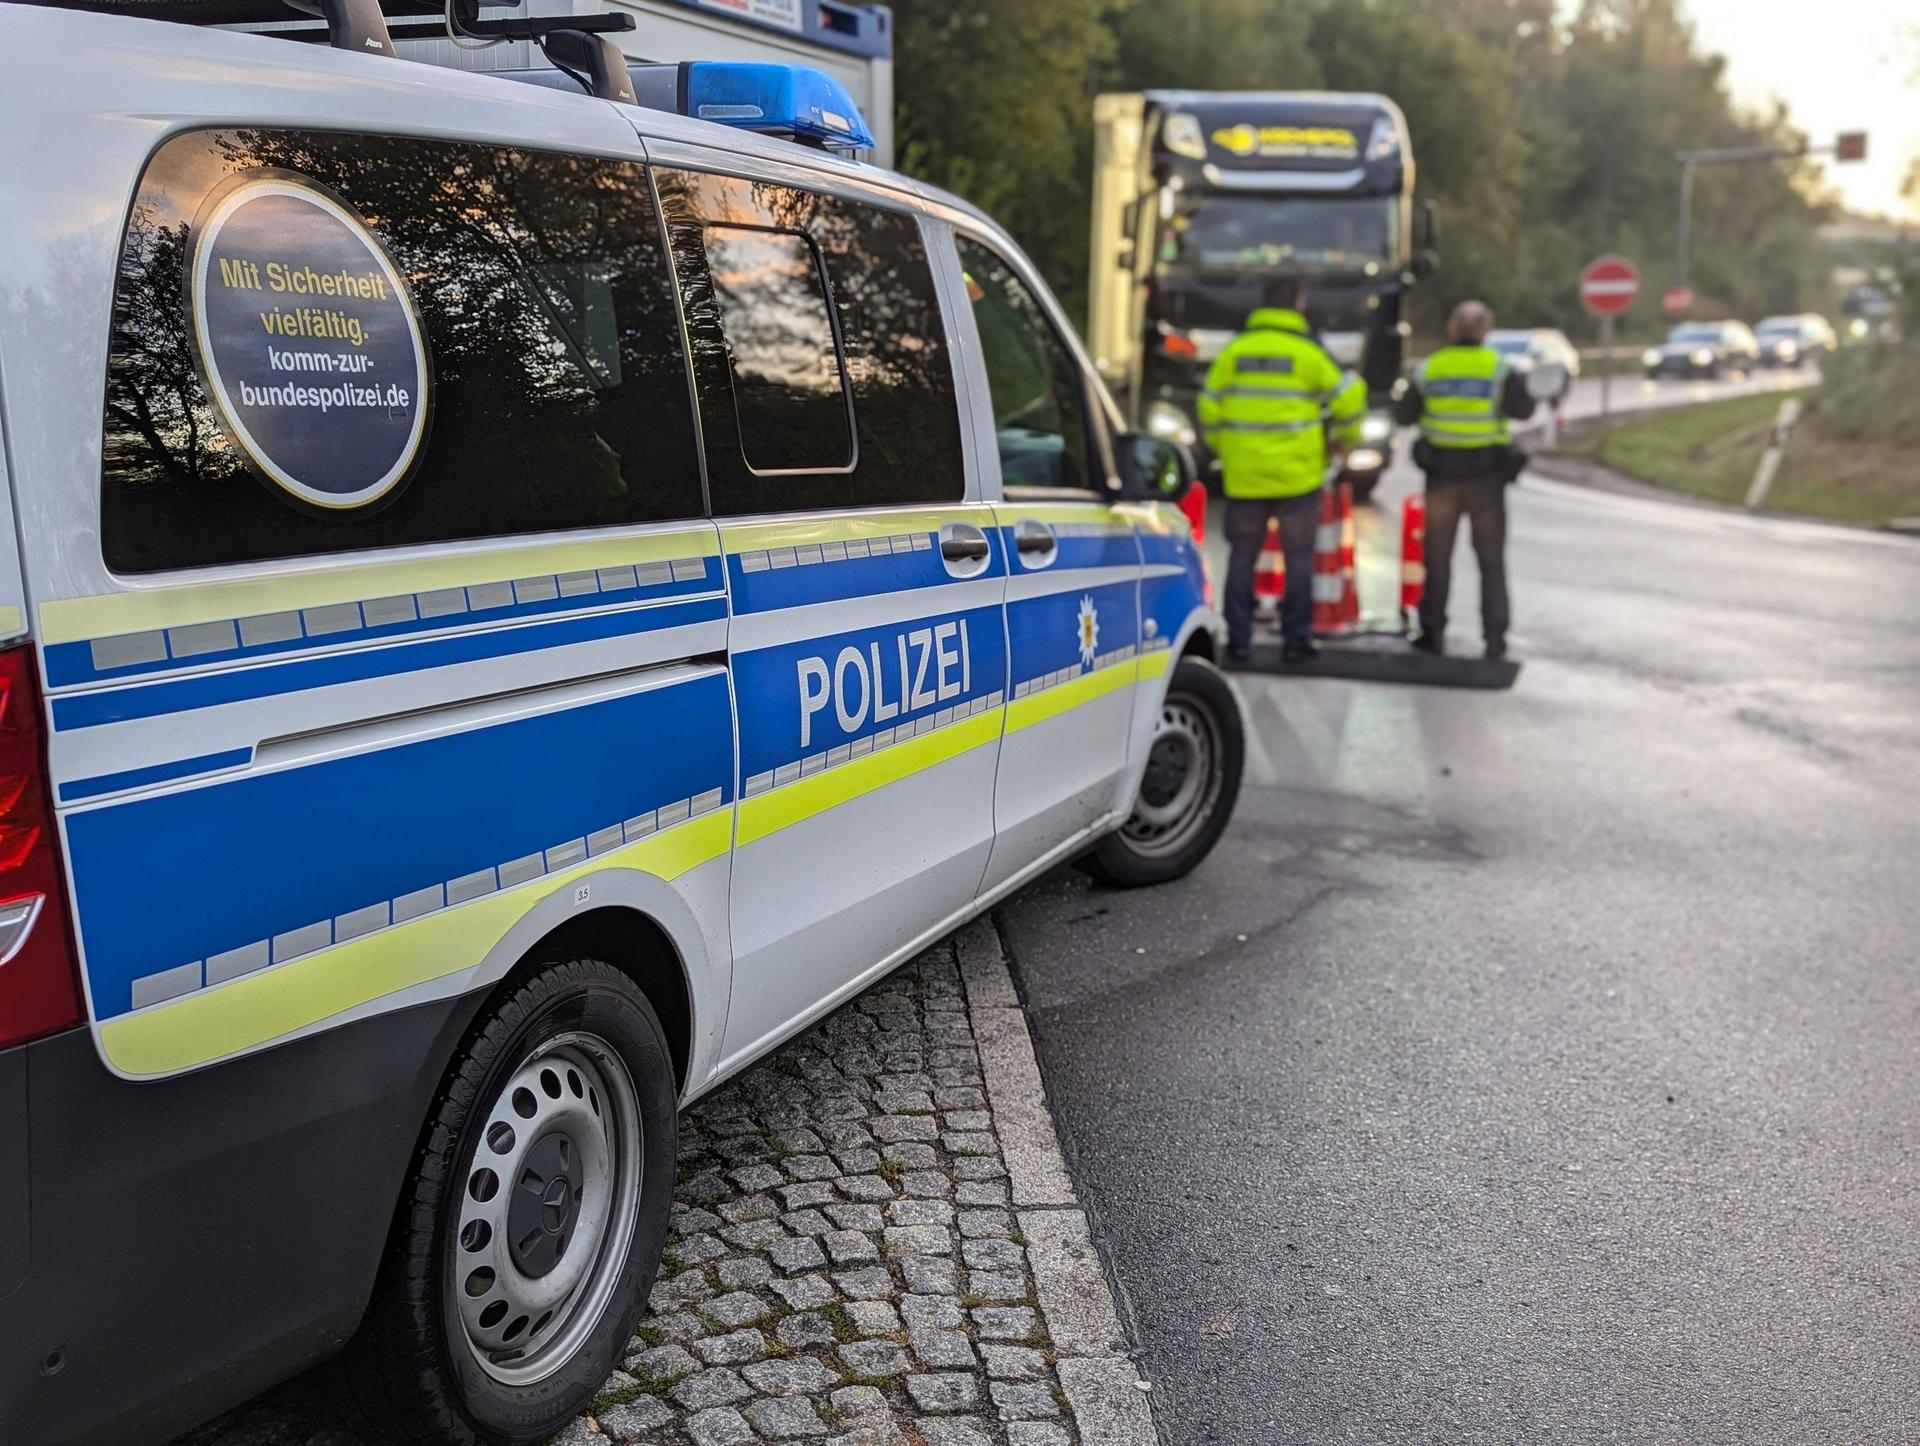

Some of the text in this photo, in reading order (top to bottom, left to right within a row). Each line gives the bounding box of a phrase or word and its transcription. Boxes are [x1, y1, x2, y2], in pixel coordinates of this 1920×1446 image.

[218, 257, 387, 300] Mit Sicherheit
[260, 306, 369, 346] vielfältig.
[268, 345, 374, 374] komm-zur-
[239, 381, 409, 412] bundespolizei.de
[797, 618, 970, 748] POLIZEI
